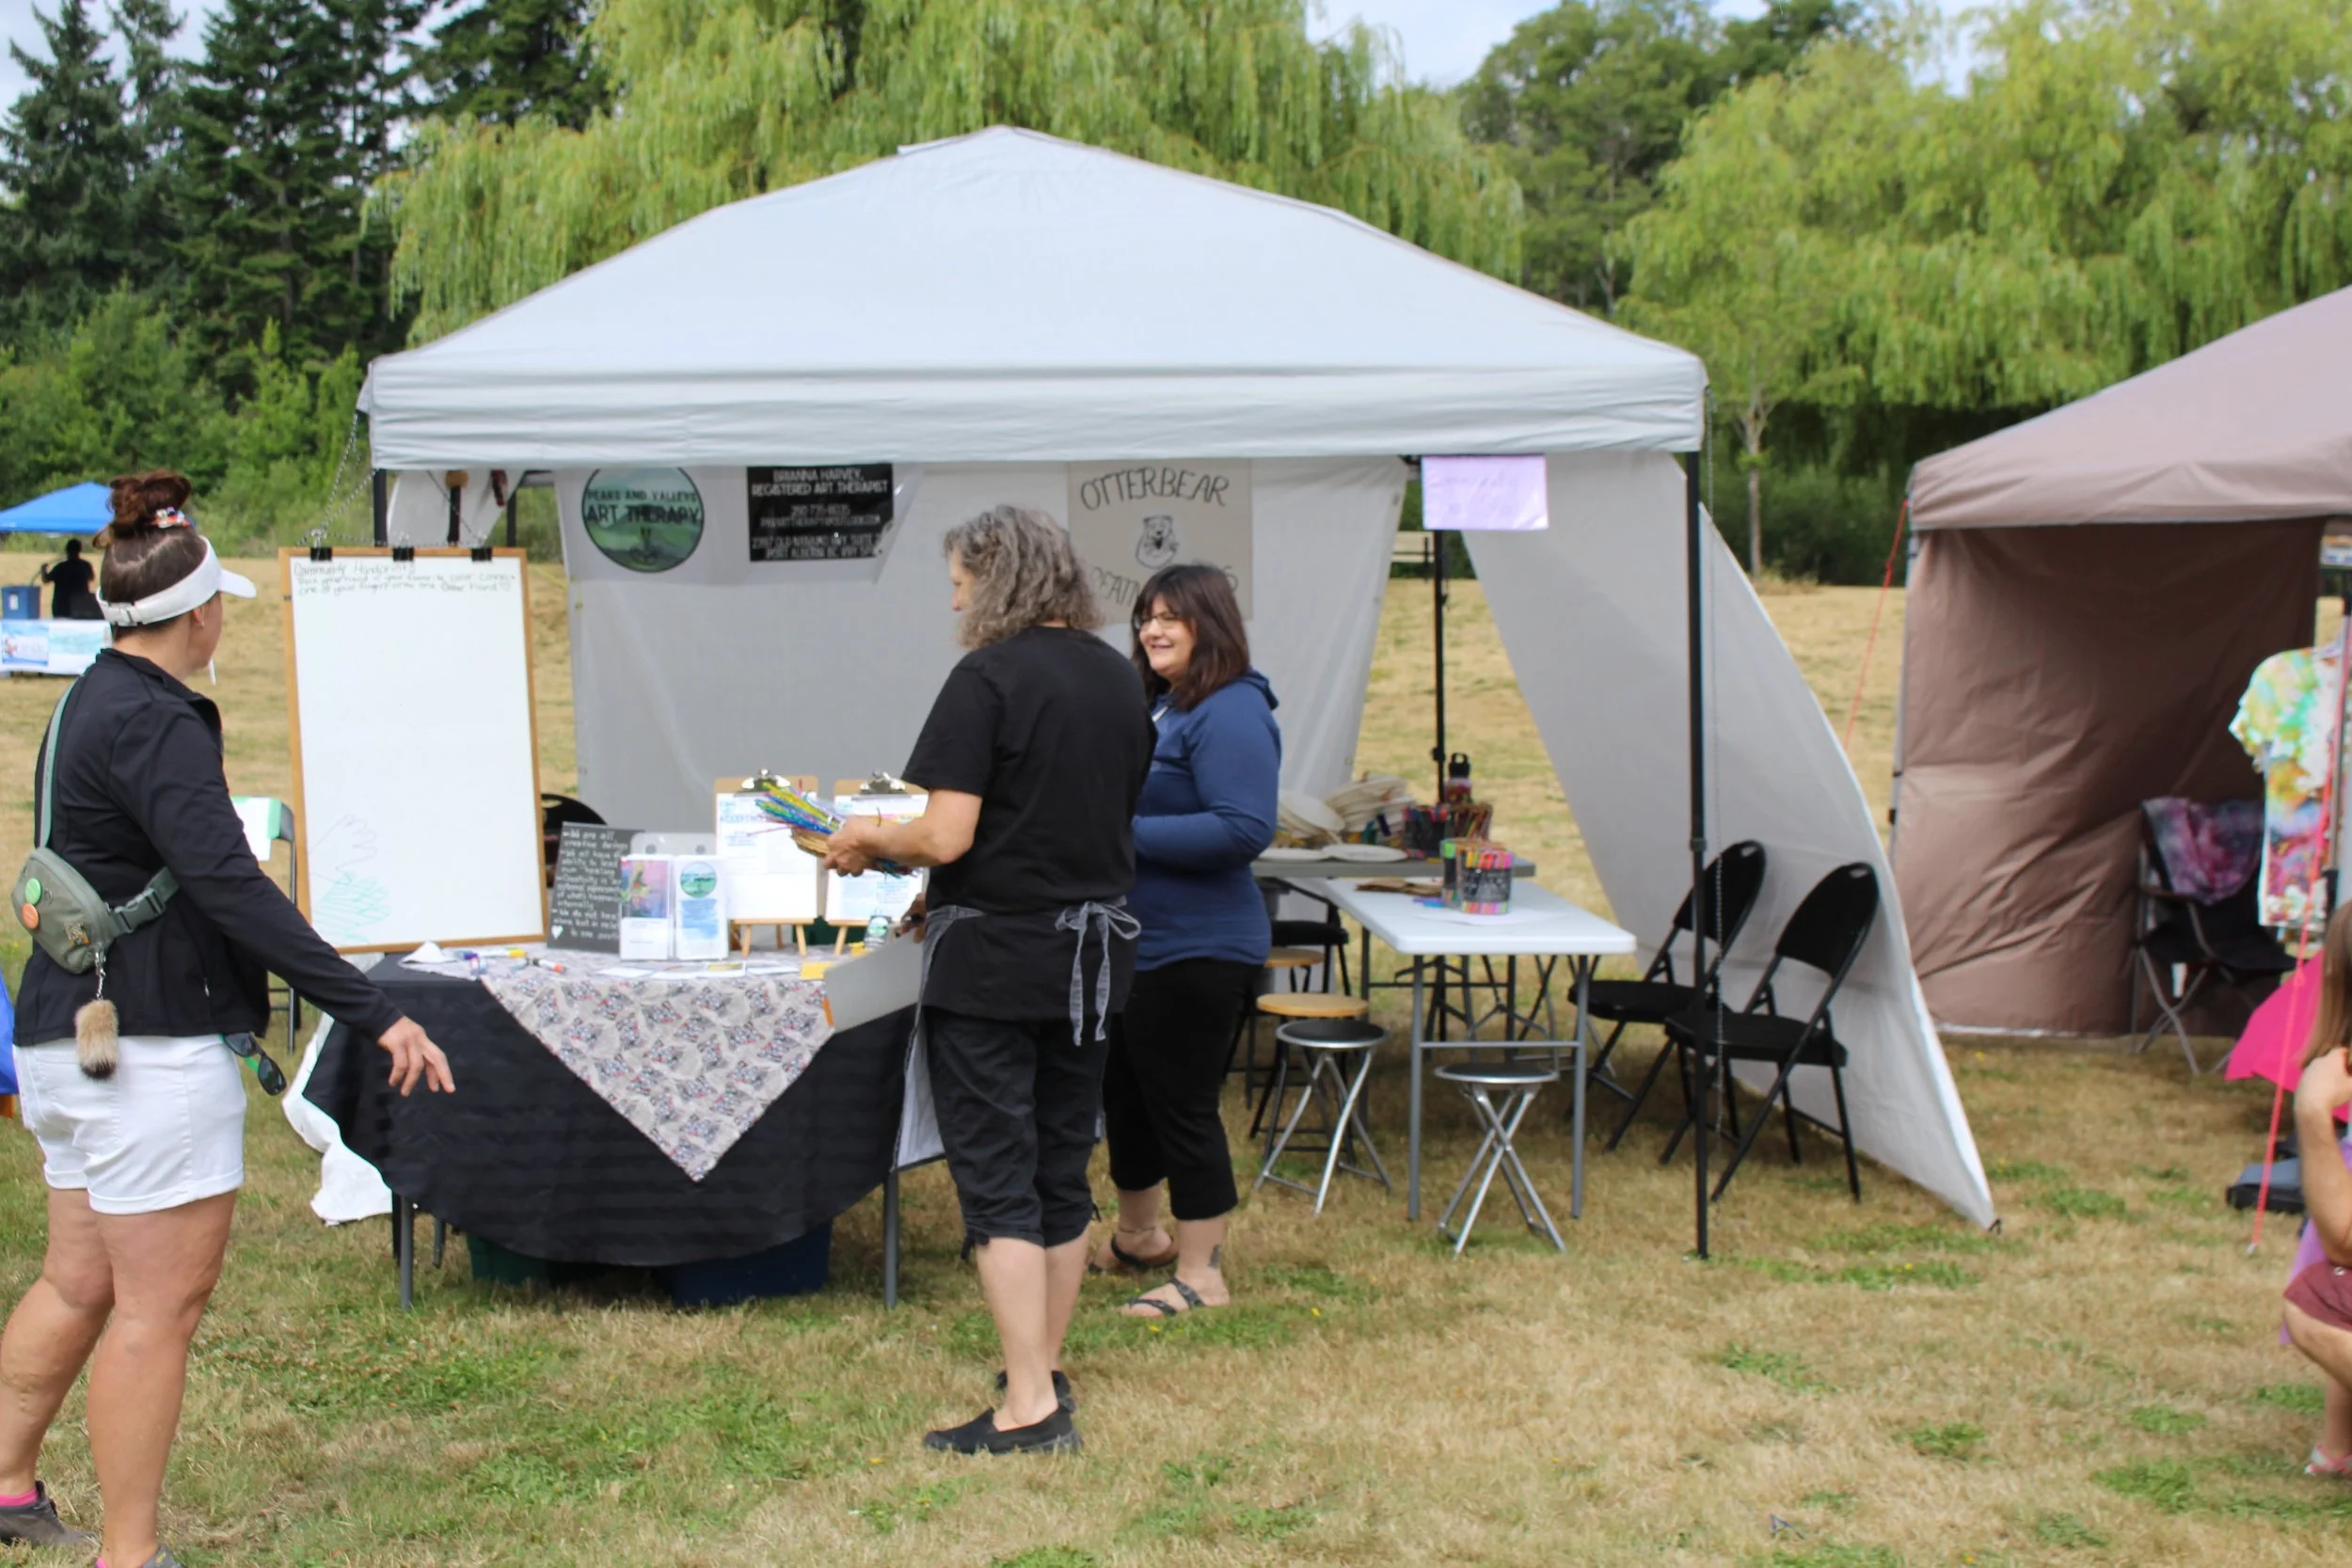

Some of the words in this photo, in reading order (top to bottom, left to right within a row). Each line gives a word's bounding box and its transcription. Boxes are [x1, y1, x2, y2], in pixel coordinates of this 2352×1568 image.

[625, 489, 648, 501] AND
[752, 483, 812, 498] REGISTERED
[814, 481, 834, 496] ART
[837, 479, 889, 494] THERAPIST
[1080, 466, 1231, 511] OTTERBEAR
[585, 503, 618, 524] ART
[625, 503, 701, 525] THERAPY
